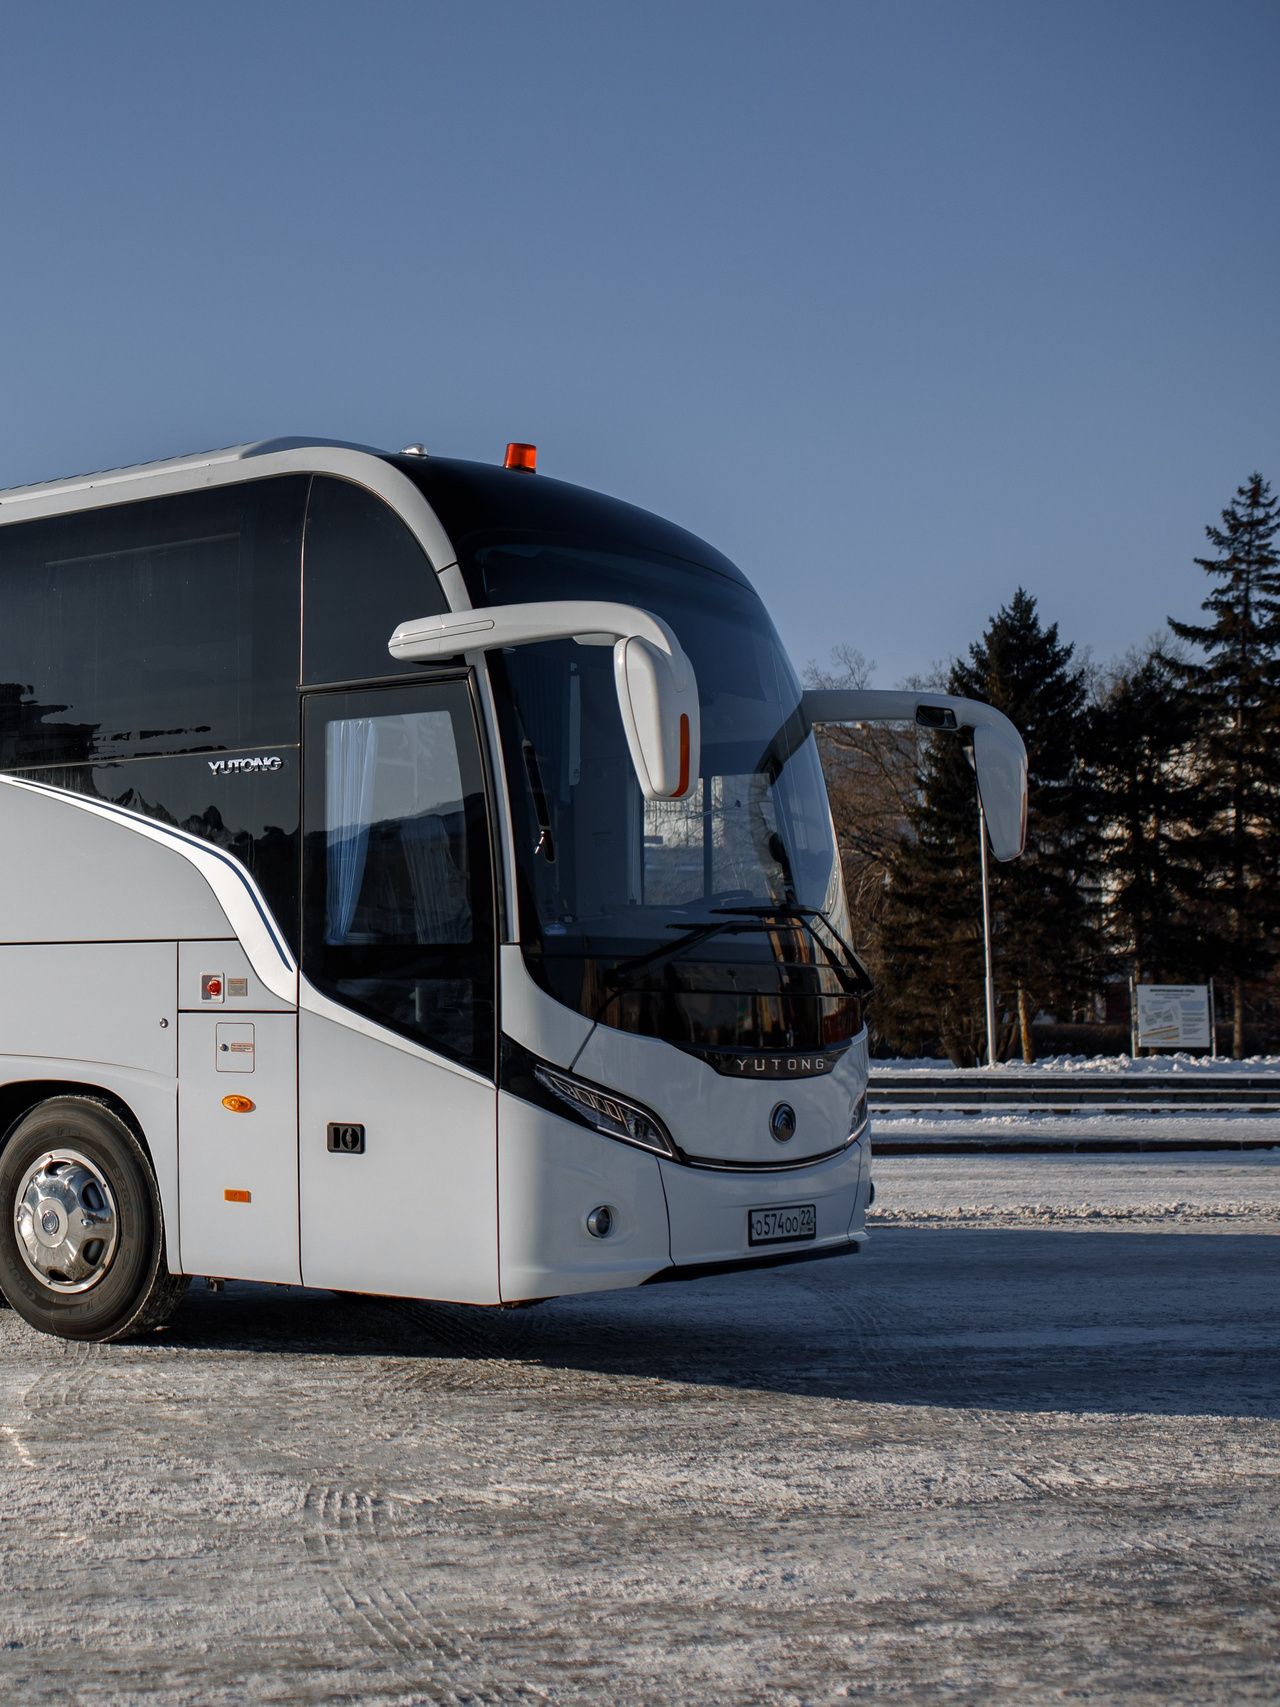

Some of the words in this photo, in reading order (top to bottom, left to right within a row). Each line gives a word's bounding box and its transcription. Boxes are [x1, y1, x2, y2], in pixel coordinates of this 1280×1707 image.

[208, 756, 282, 776] YUTONG
[737, 1058, 824, 1071] YUTONG
[114, 1167, 132, 1217] S200
